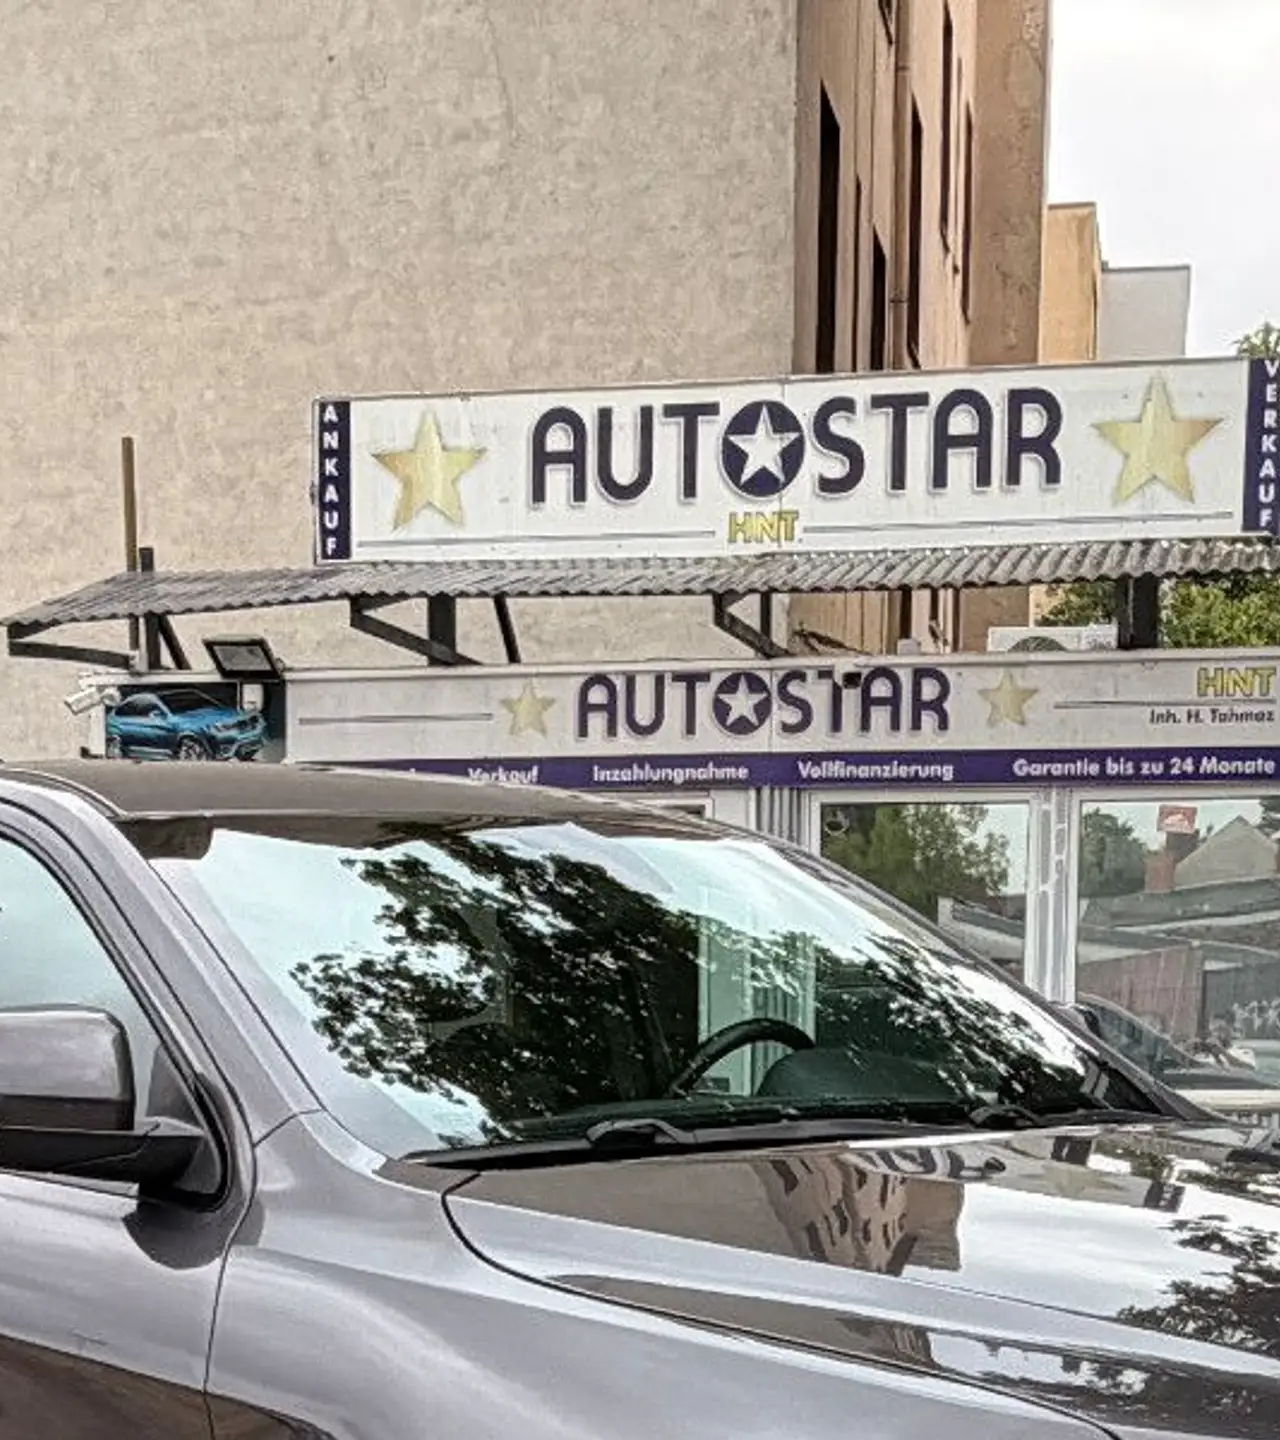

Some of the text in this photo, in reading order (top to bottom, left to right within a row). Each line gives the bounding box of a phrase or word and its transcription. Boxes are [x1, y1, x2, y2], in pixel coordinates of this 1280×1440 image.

[531, 388, 1063, 503] AUTOSTAR
[1258, 358, 1279, 528] VERKAUF
[322, 403, 339, 556] ANKAUF
[727, 510, 800, 543] HNT
[578, 666, 951, 738] AUTOSTAR
[1197, 667, 1276, 697] HNT
[1149, 708, 1181, 724] Inh.
[1187, 708, 1204, 724] H.
[592, 760, 749, 784] Inzahlungnahme
[797, 759, 954, 781] Vollfinanzierung
[1011, 757, 1100, 777] Garantie
[1106, 756, 1134, 776] bis
[1139, 761, 1164, 775] zu
[1169, 757, 1195, 775] 24
[1199, 755, 1276, 775] Monate
